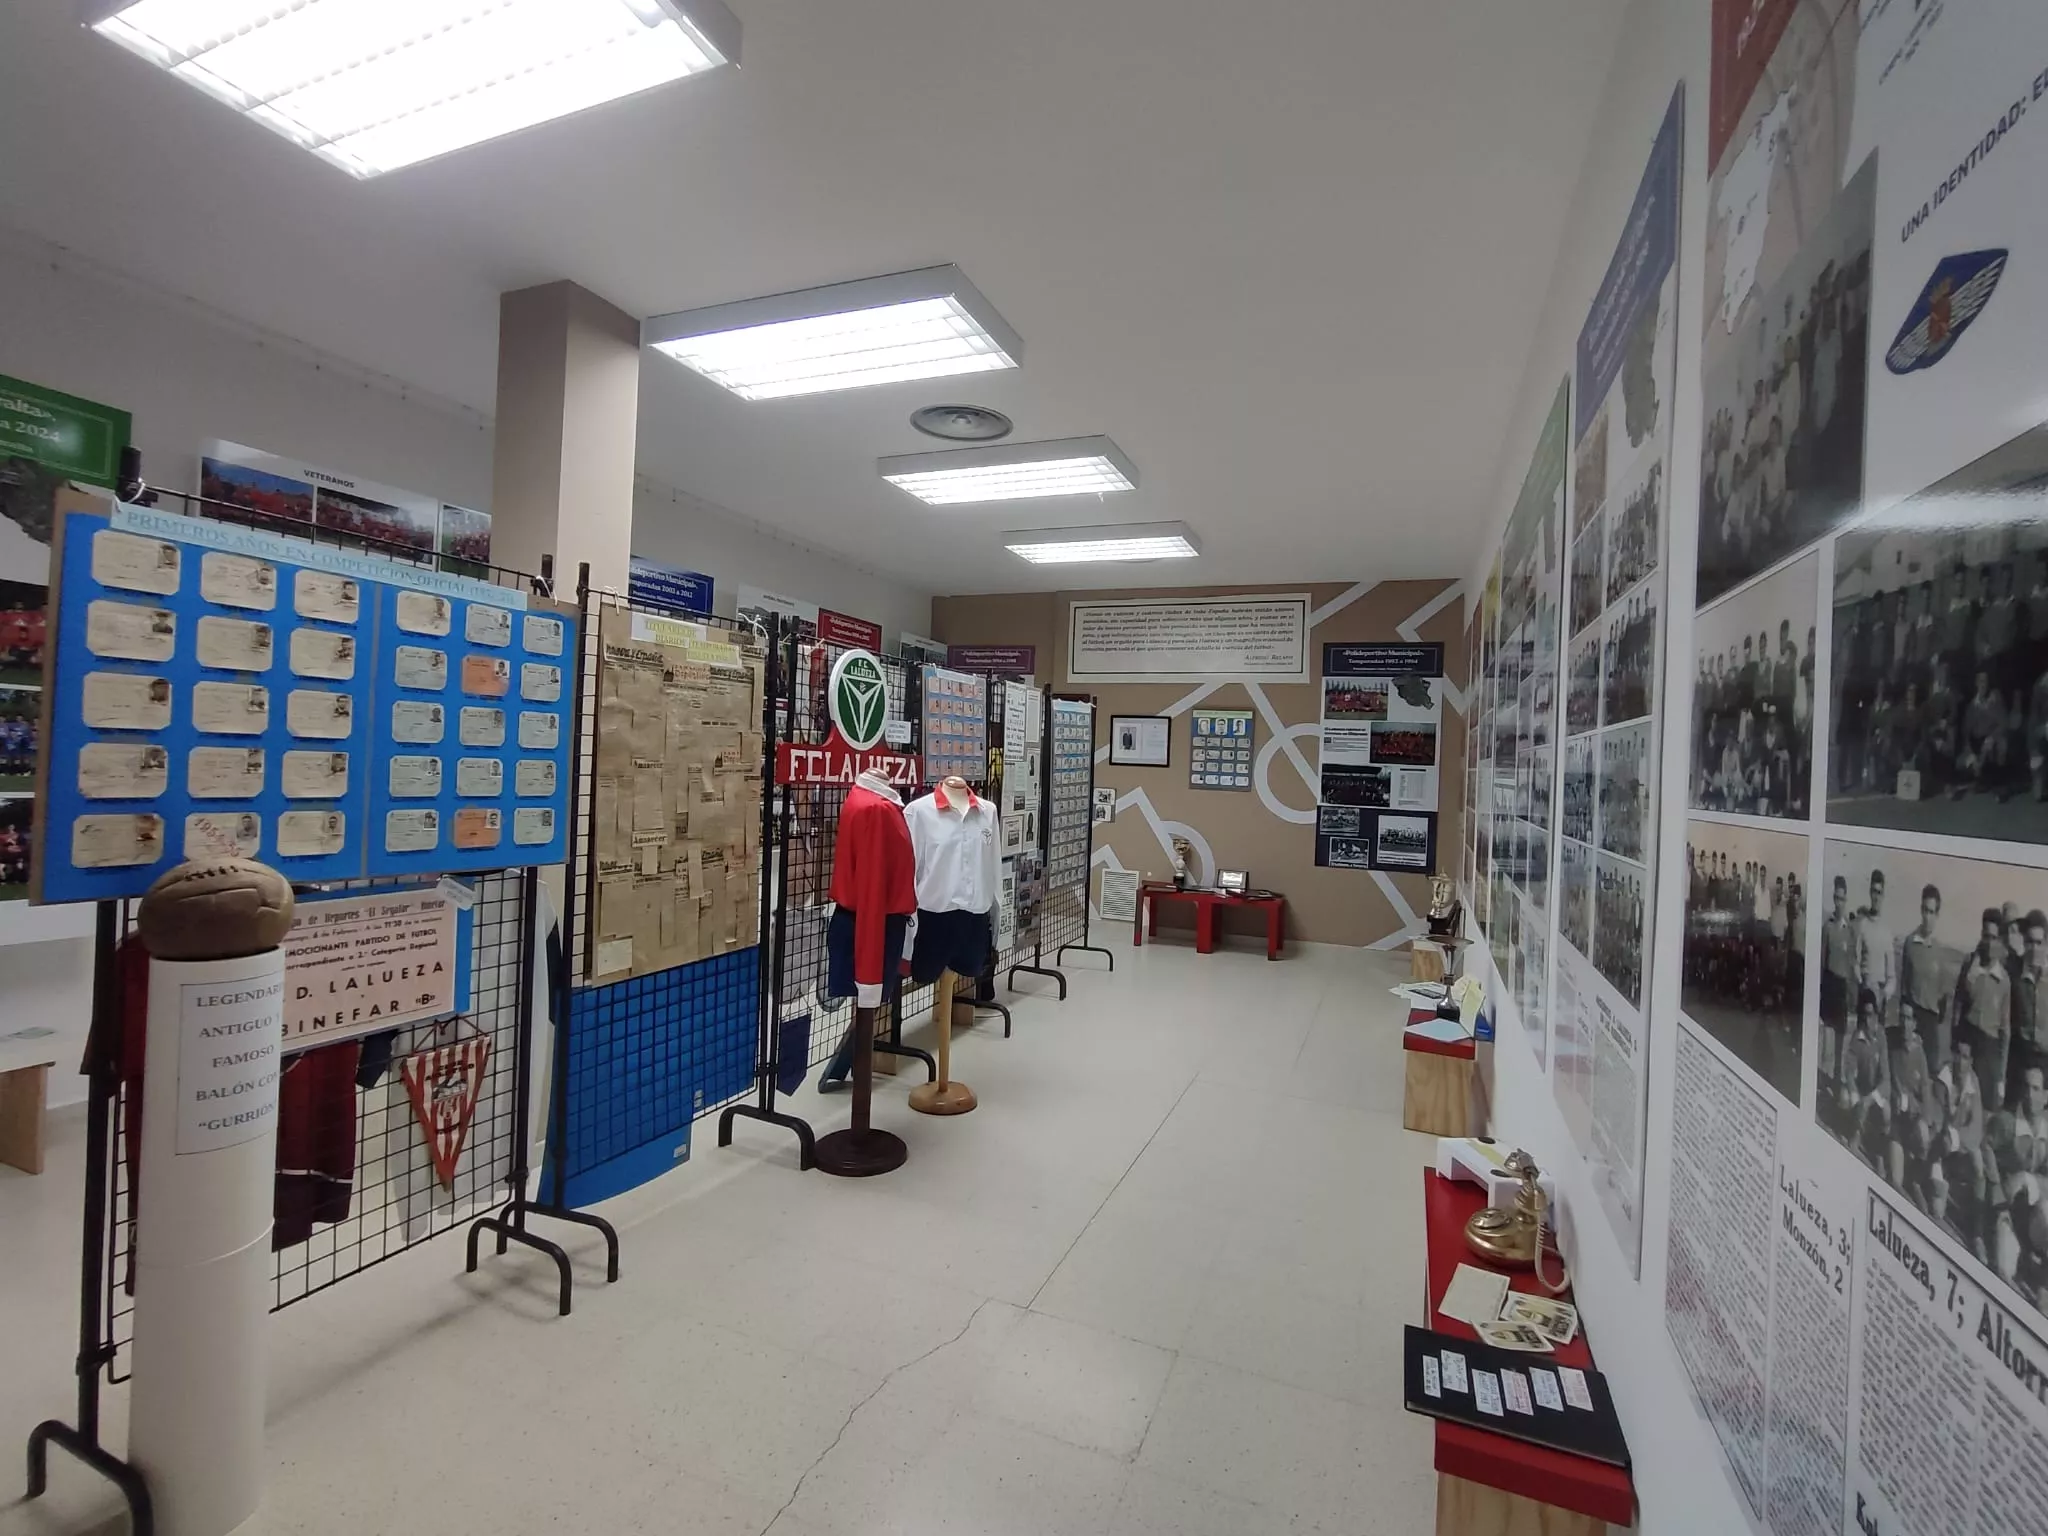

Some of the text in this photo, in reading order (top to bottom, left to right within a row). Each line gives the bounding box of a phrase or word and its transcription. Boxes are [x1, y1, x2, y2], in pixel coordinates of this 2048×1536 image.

[1902, 202, 1929, 243] UNA
[1933, 96, 2026, 210] IDENTIDAD:
[303, 468, 354, 488] VETERANOS
[127, 511, 229, 546] PRIMEROS
[235, 532, 279, 557] AÑOS
[850, 665, 876, 679] LALUEZA
[355, 935, 390, 947] PARTIDO
[396, 932, 406, 941] DE
[296, 961, 444, 1000] D. LALUEZA
[199, 1016, 272, 1039] ANTIGUO
[212, 1045, 274, 1069] FAMOSO
[196, 1079, 254, 1102] BALÓN
[1780, 1164, 1833, 1246] Lalueza,
[1783, 1204, 1844, 1295] Monzón, 2
[1868, 1196, 1936, 1302] Lalueza,
[1947, 1269, 1965, 1330] 7;
